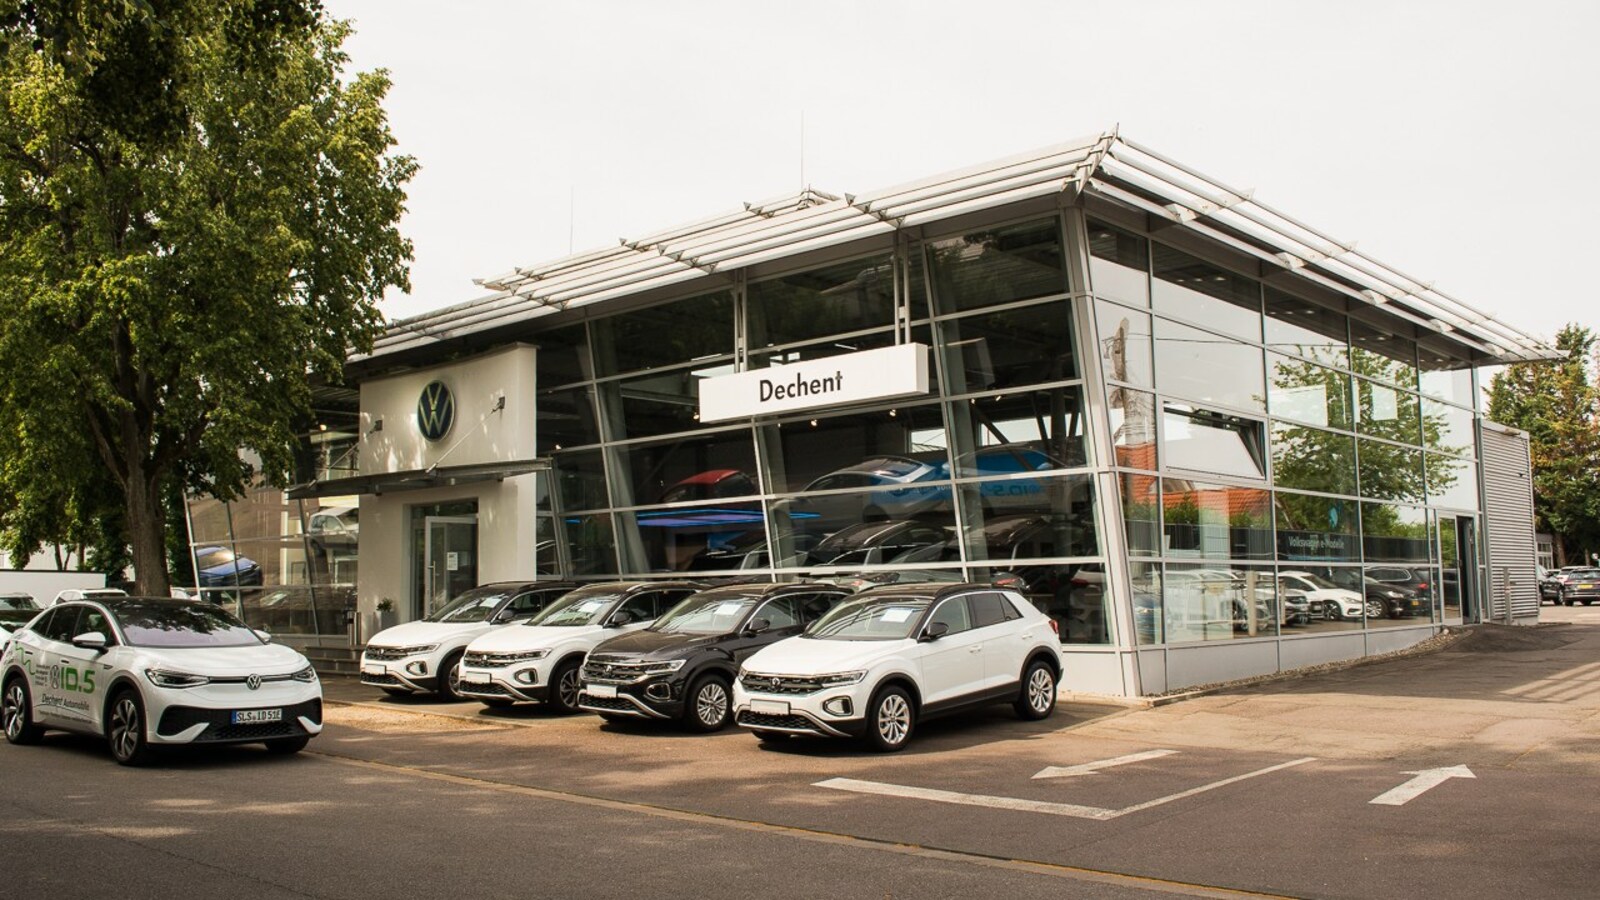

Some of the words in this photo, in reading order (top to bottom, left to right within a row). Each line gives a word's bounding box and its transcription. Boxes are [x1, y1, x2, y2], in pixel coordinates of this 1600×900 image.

[759, 371, 843, 402] Dechent
[61, 666, 96, 694] ID.5
[237, 711, 252, 721] SLS
